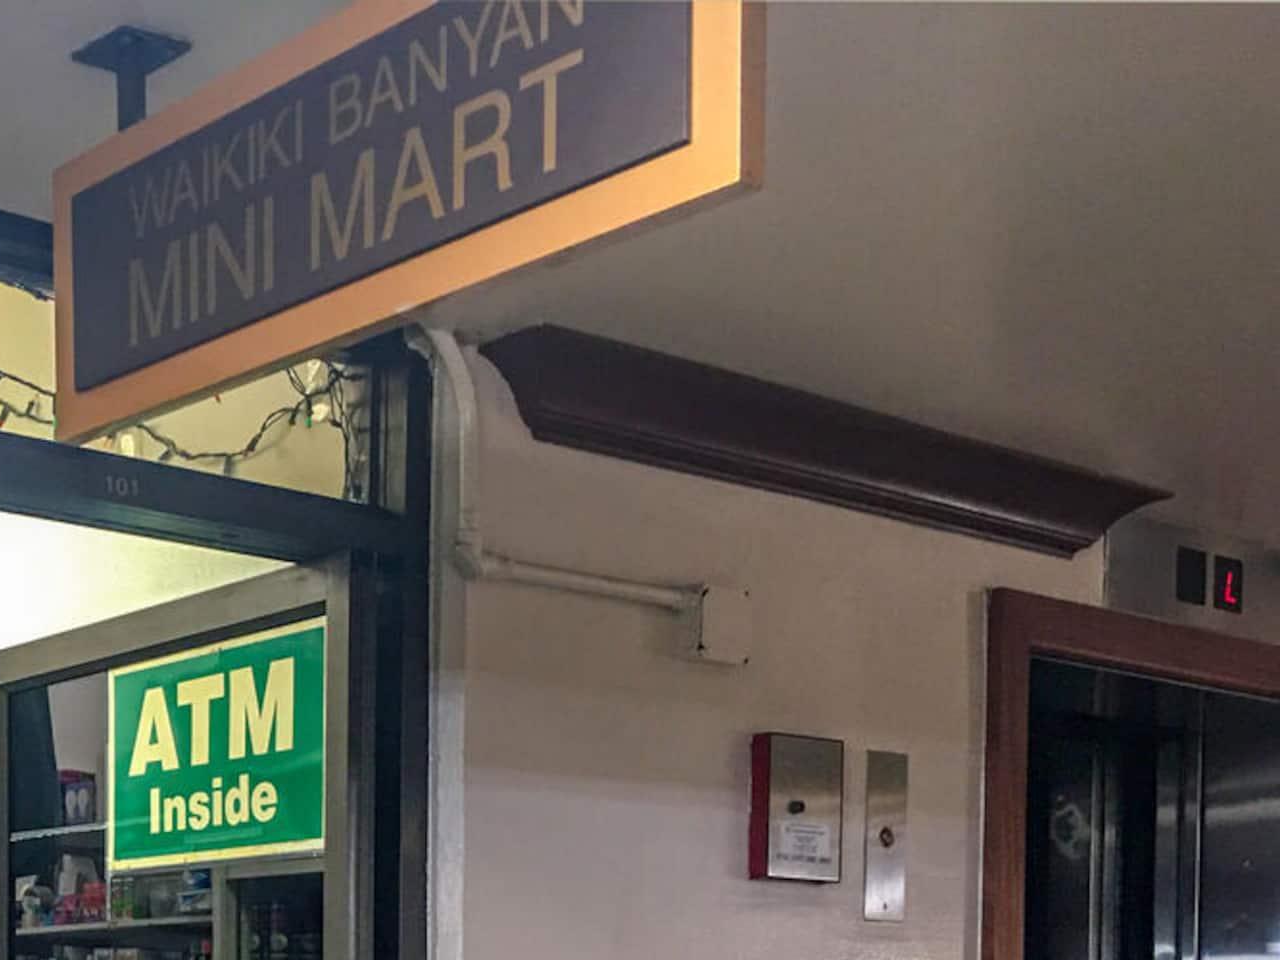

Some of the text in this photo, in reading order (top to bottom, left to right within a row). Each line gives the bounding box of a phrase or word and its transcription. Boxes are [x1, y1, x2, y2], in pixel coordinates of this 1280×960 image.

[129, 100, 303, 239] WAIKIKI
[129, 48, 584, 347] MINI MART
[106, 475, 139, 497] 101
[128, 656, 294, 777] ATM
[149, 773, 278, 835] Inside
